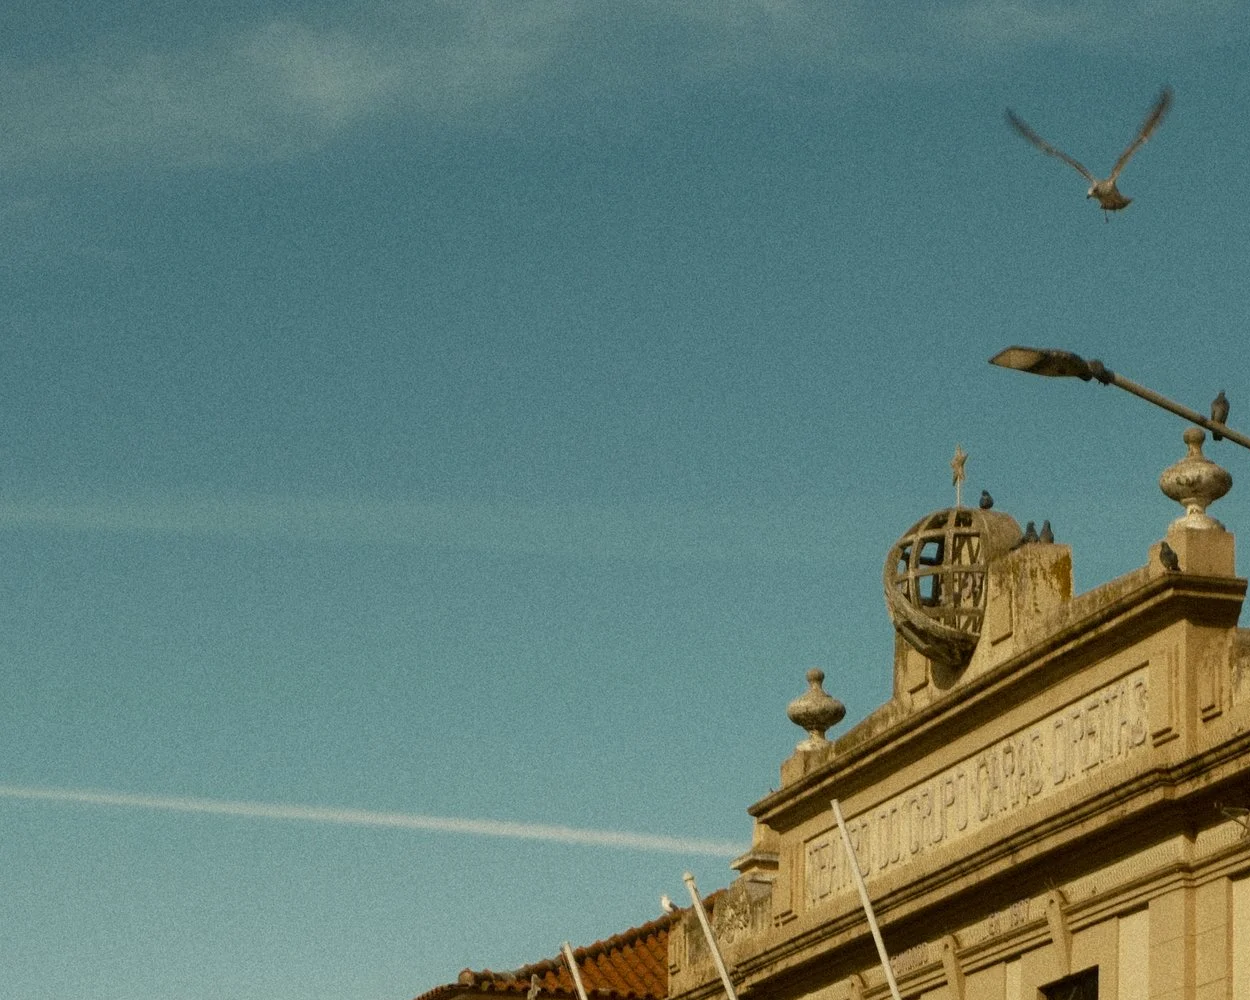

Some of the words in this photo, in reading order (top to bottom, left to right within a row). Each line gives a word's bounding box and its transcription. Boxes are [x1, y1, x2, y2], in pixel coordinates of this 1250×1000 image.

[873, 805, 900, 870] DO
[907, 771, 969, 855] GRUPO
[976, 729, 1043, 822] CARAS
[1052, 677, 1149, 786] DIREITAS
